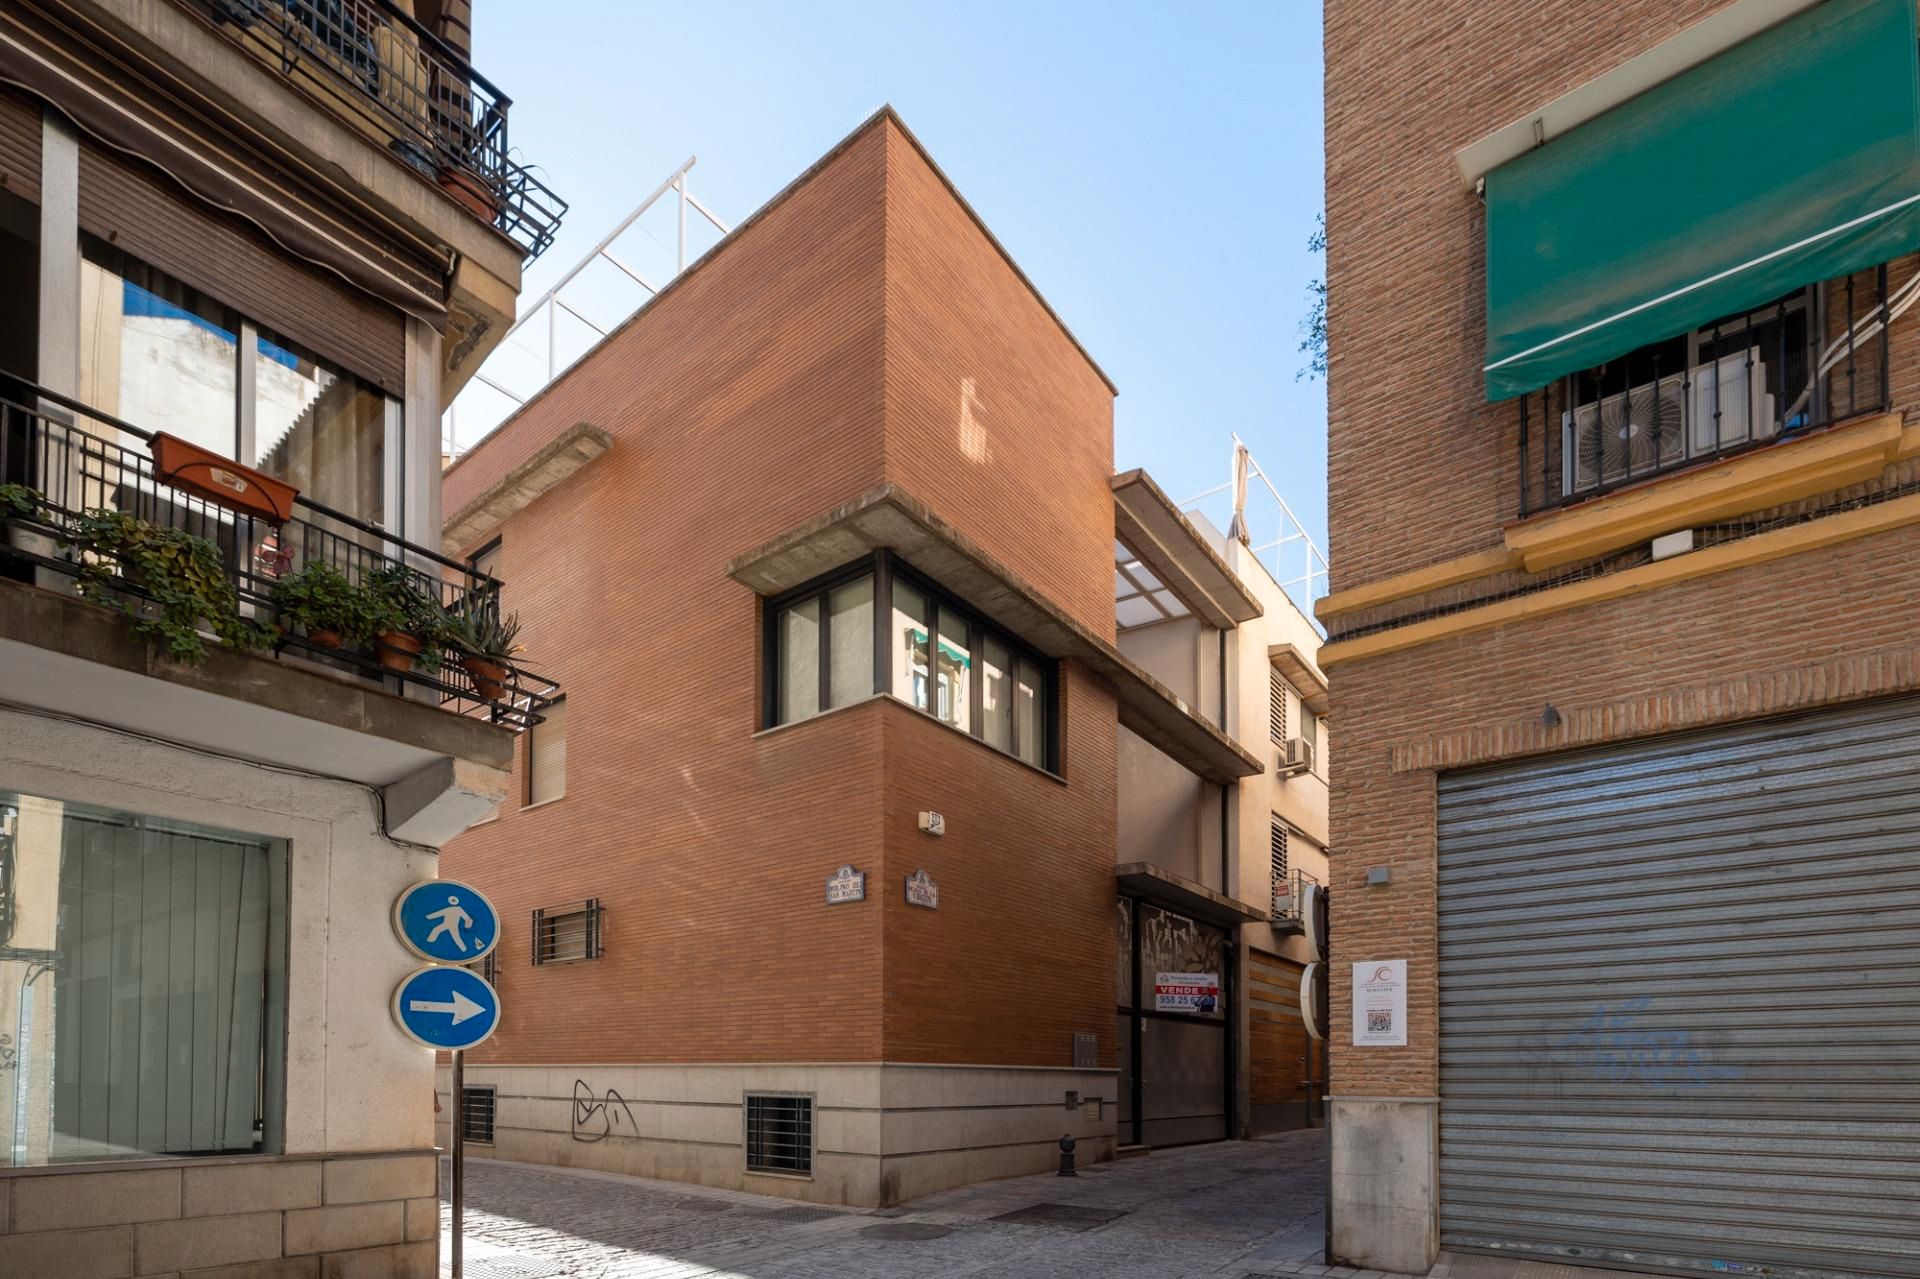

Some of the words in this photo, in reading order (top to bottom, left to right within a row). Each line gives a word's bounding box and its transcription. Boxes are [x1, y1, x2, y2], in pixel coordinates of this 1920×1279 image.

[1160, 986, 1199, 994] VENDE
[1160, 995, 1175, 1004] 958
[1177, 995, 1188, 1004] 25
